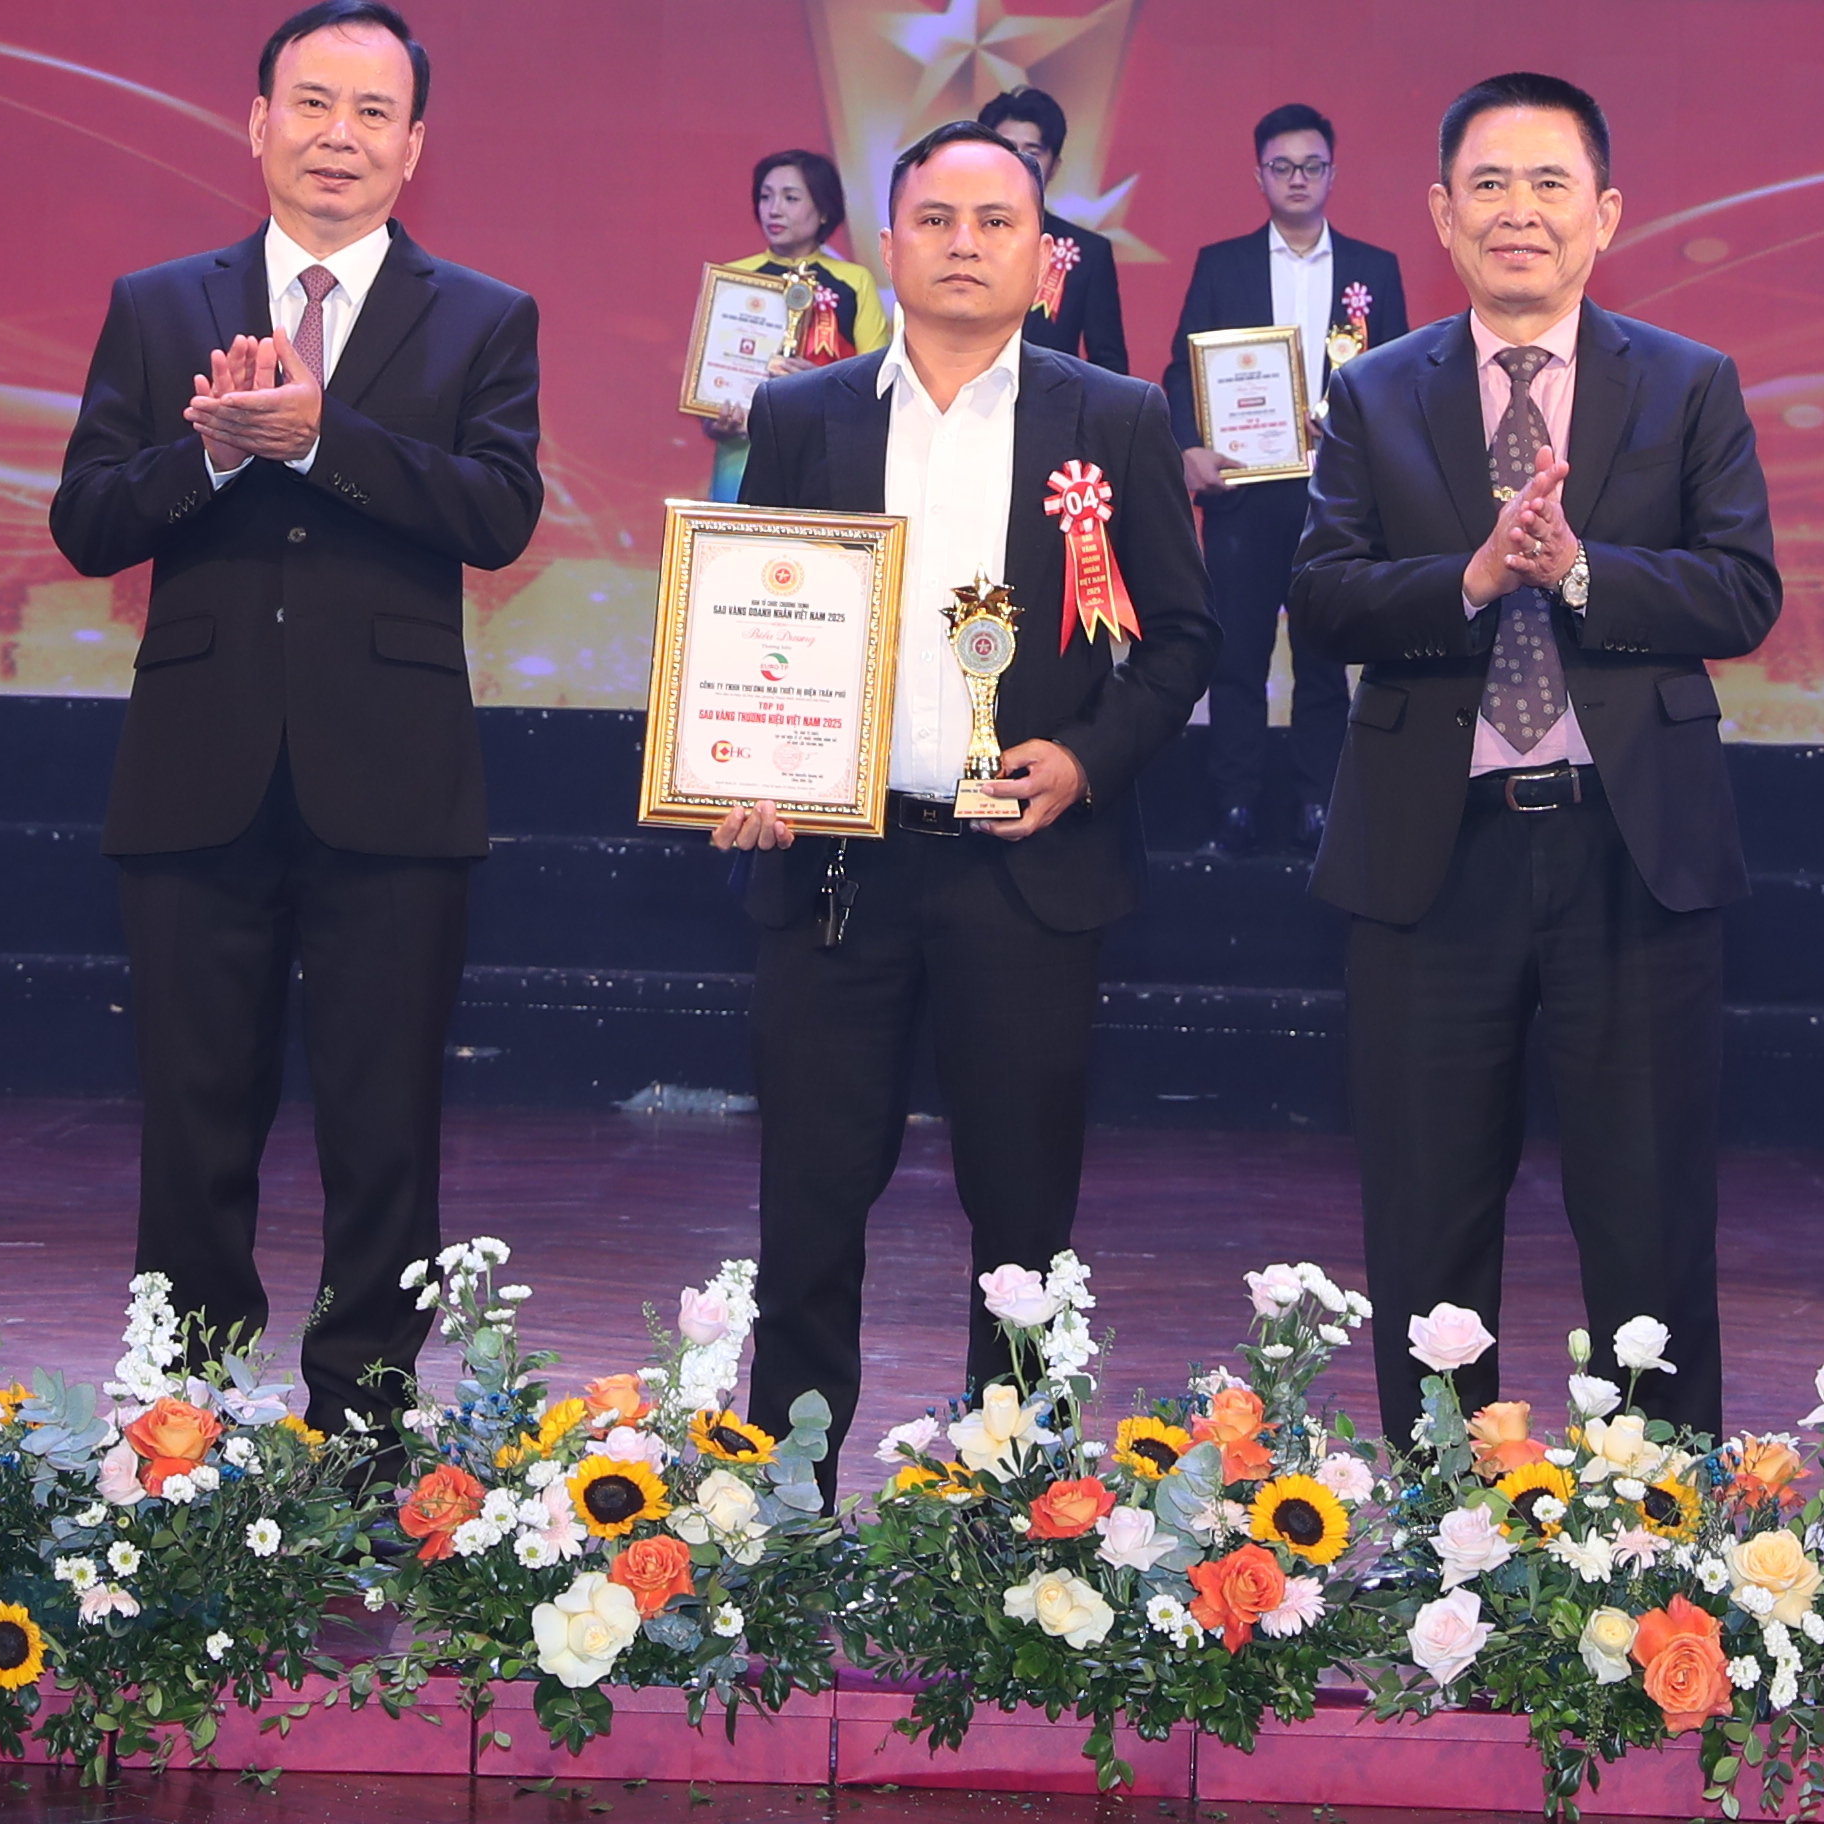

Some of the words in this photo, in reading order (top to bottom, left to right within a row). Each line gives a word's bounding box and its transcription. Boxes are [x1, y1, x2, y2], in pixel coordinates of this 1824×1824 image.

[1065, 485, 1099, 515] 04
[809, 611, 826, 621] NAM
[827, 612, 846, 623] 2025
[758, 701, 773, 711] TOP
[776, 703, 784, 711] 10
[699, 709, 714, 719] SAO
[715, 708, 735, 722] VÀNG
[803, 717, 821, 727] NAM
[822, 718, 842, 729] 2025
